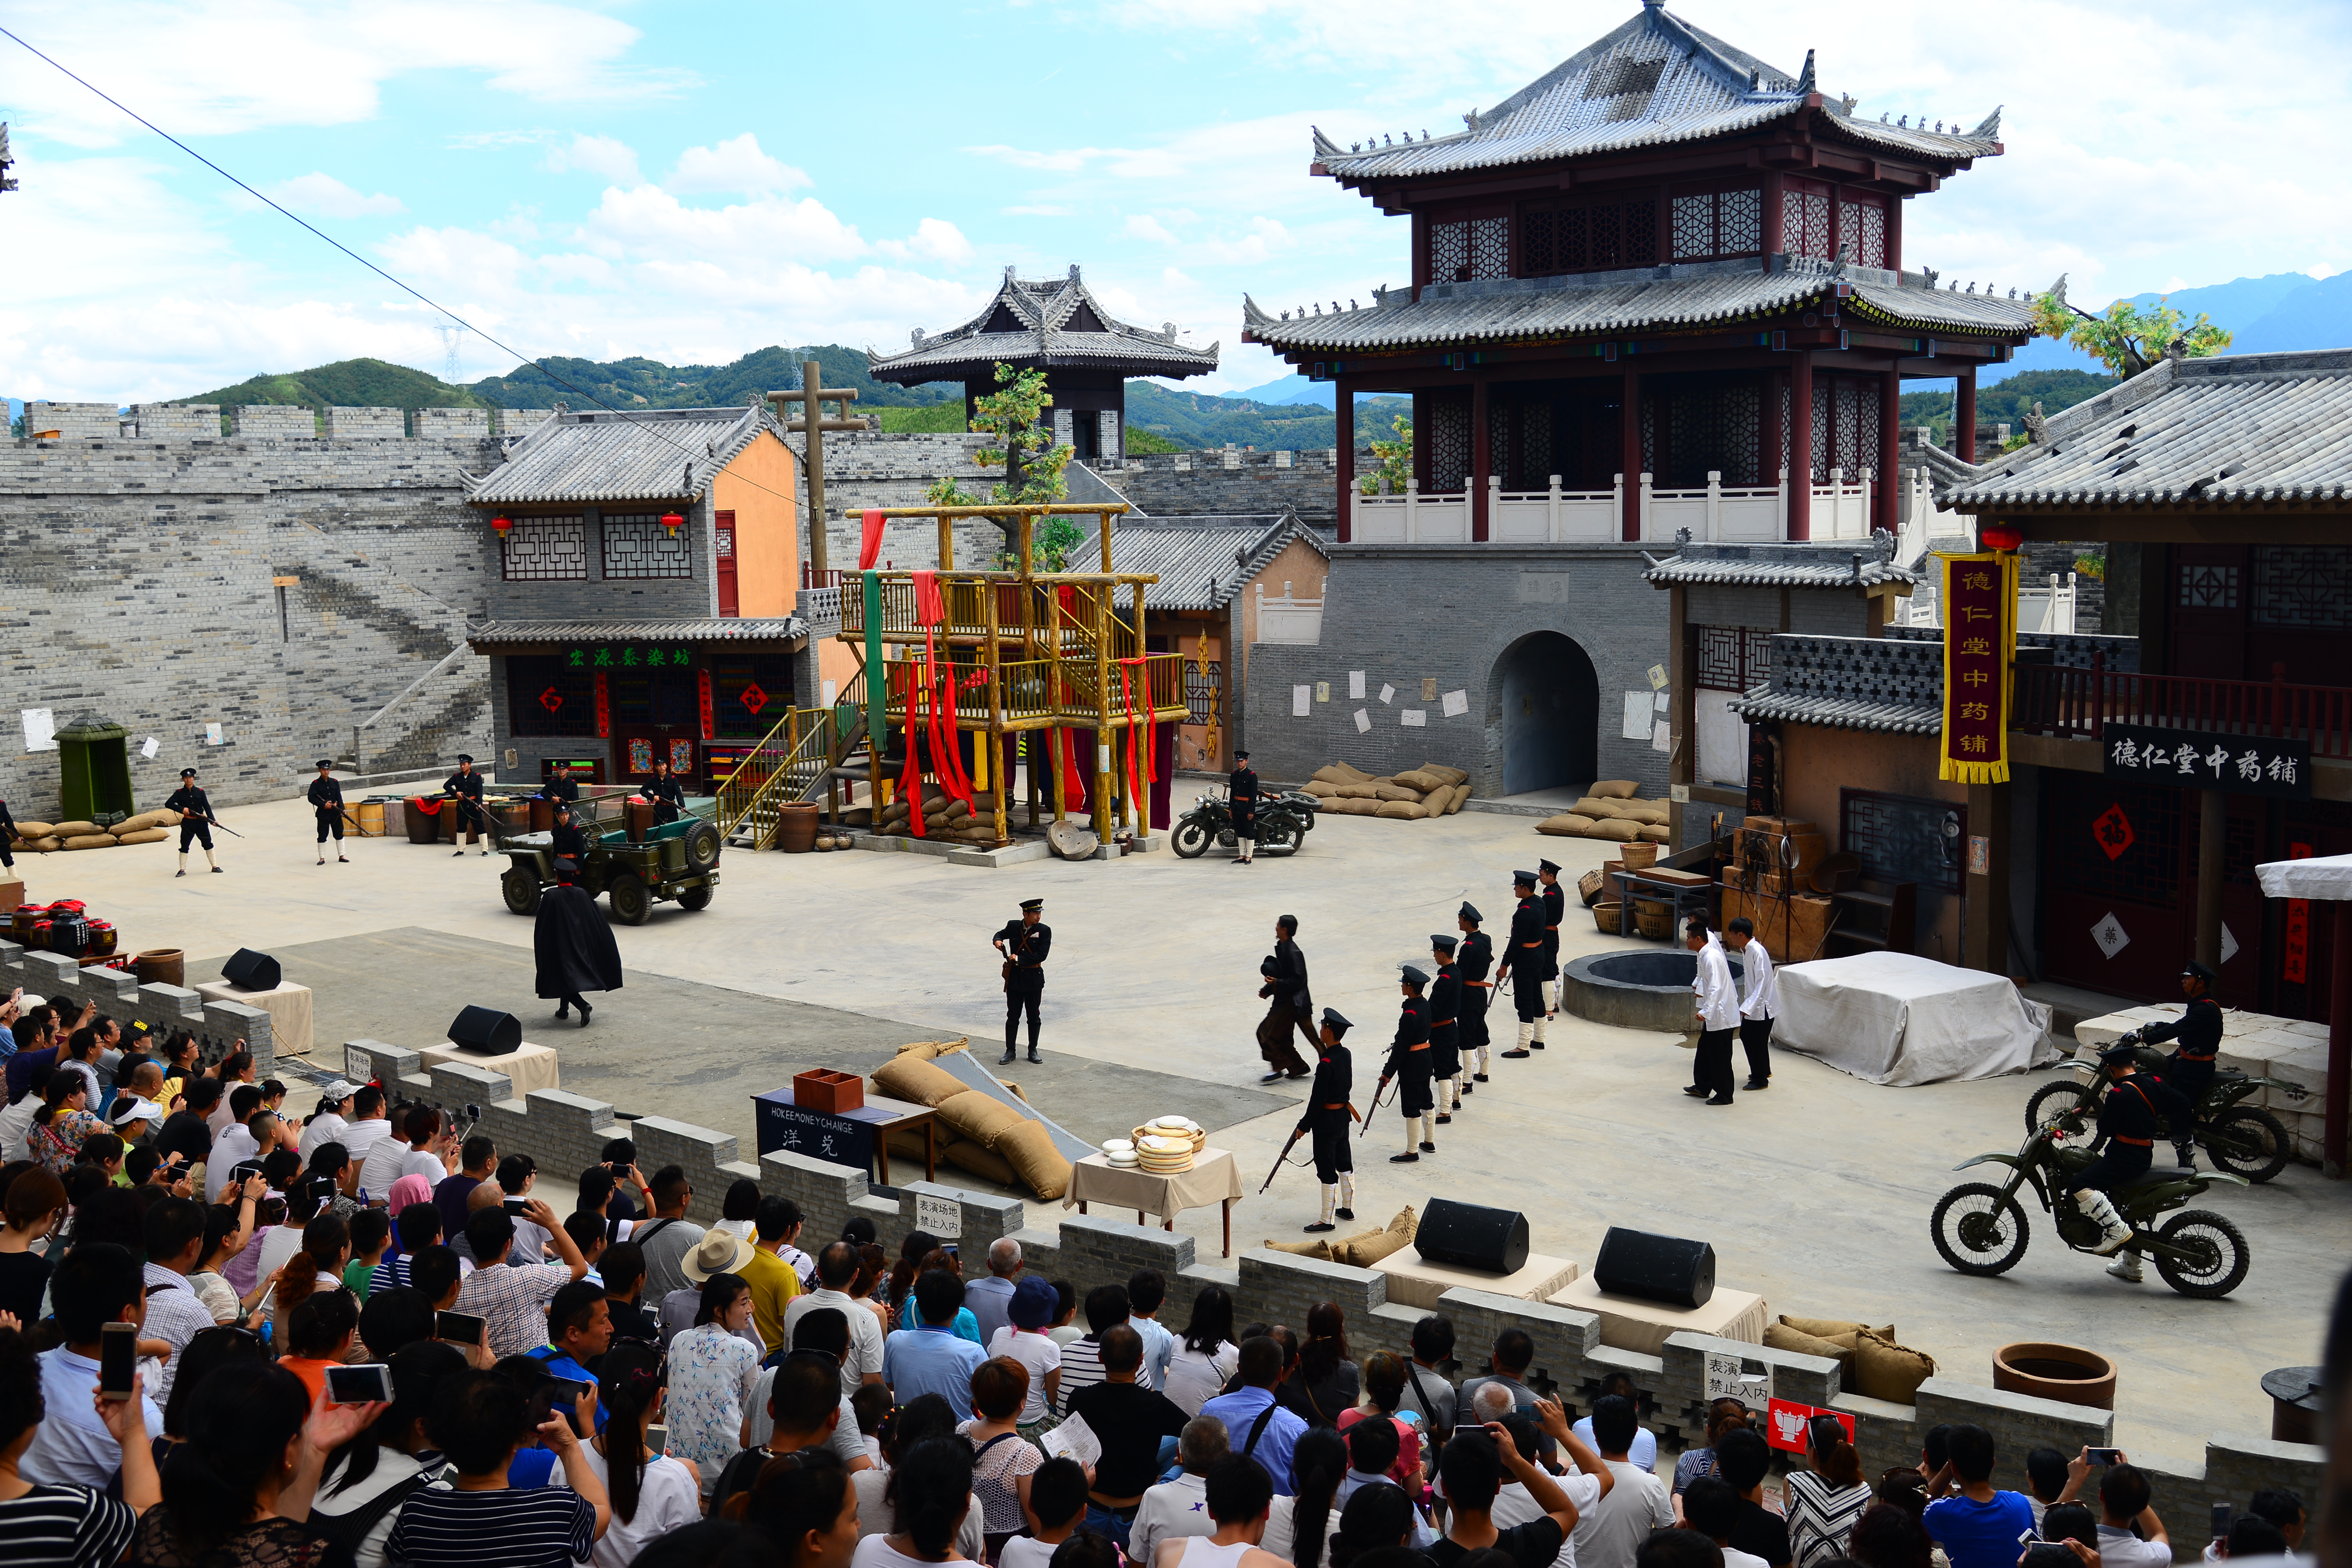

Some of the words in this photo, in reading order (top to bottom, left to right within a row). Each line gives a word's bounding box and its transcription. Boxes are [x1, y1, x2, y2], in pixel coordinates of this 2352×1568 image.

[1526, 580, 1562, 593] 鐘樓
[570, 647, 691, 666] 宏源泰染坊
[1960, 572, 1994, 753] 德仁堂中药铺
[746, 689, 761, 708] 福
[2111, 738, 2298, 785] 德仁堂中药铺
[1751, 732, 1765, 812] 秦老三铁
[2101, 813, 2126, 847] 福
[2103, 926, 2117, 945] 藥
[349, 1052, 369, 1067] 表演场地
[350, 1064, 370, 1079] 禁止入内
[920, 1199, 958, 1217] 表演场地
[920, 1215, 958, 1233] 禁止入内
[1709, 1377, 1767, 1402] 禁止入内
